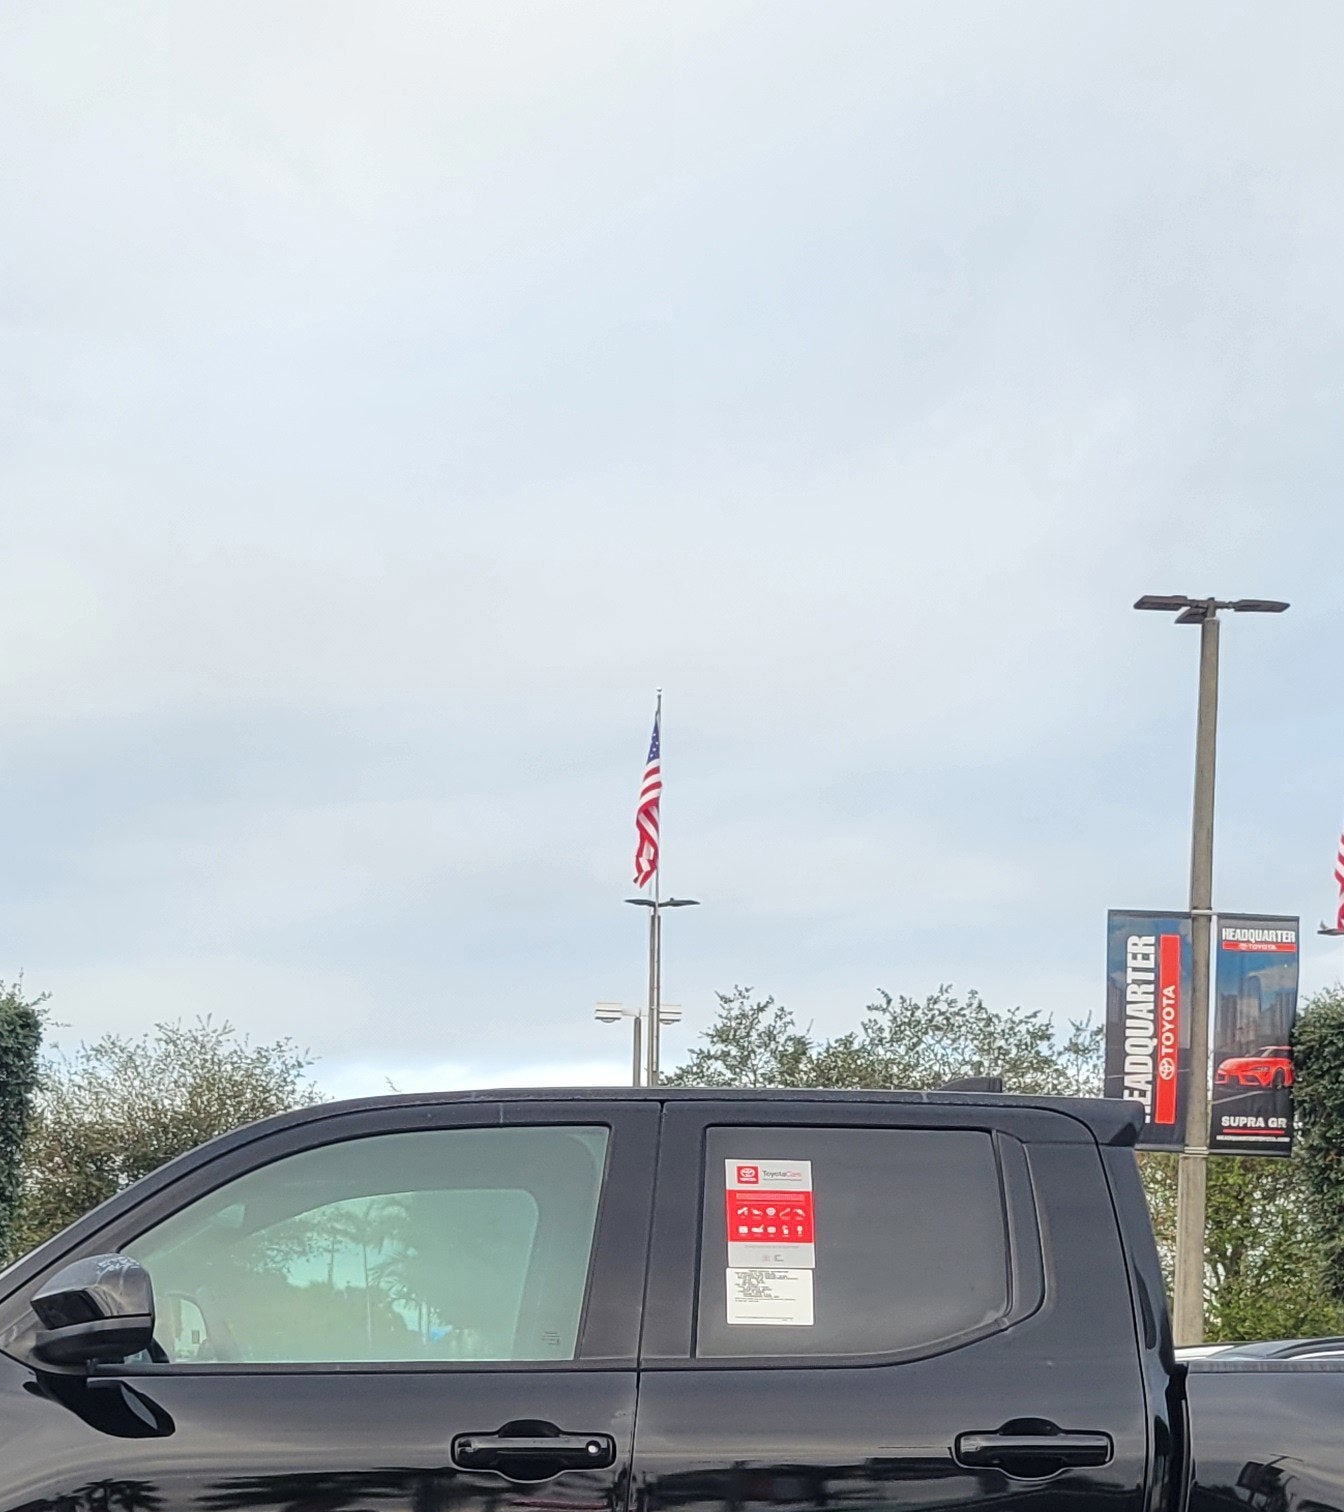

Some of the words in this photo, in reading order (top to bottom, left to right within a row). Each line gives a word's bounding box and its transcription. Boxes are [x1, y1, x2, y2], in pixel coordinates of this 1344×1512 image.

[1222, 928, 1296, 943] HEADQUARTER
[1123, 934, 1158, 1124] EADQUARTER
[1161, 985, 1176, 1056] TOYOTA
[1221, 1115, 1265, 1128] SUPRA
[1268, 1117, 1287, 1129] GR
